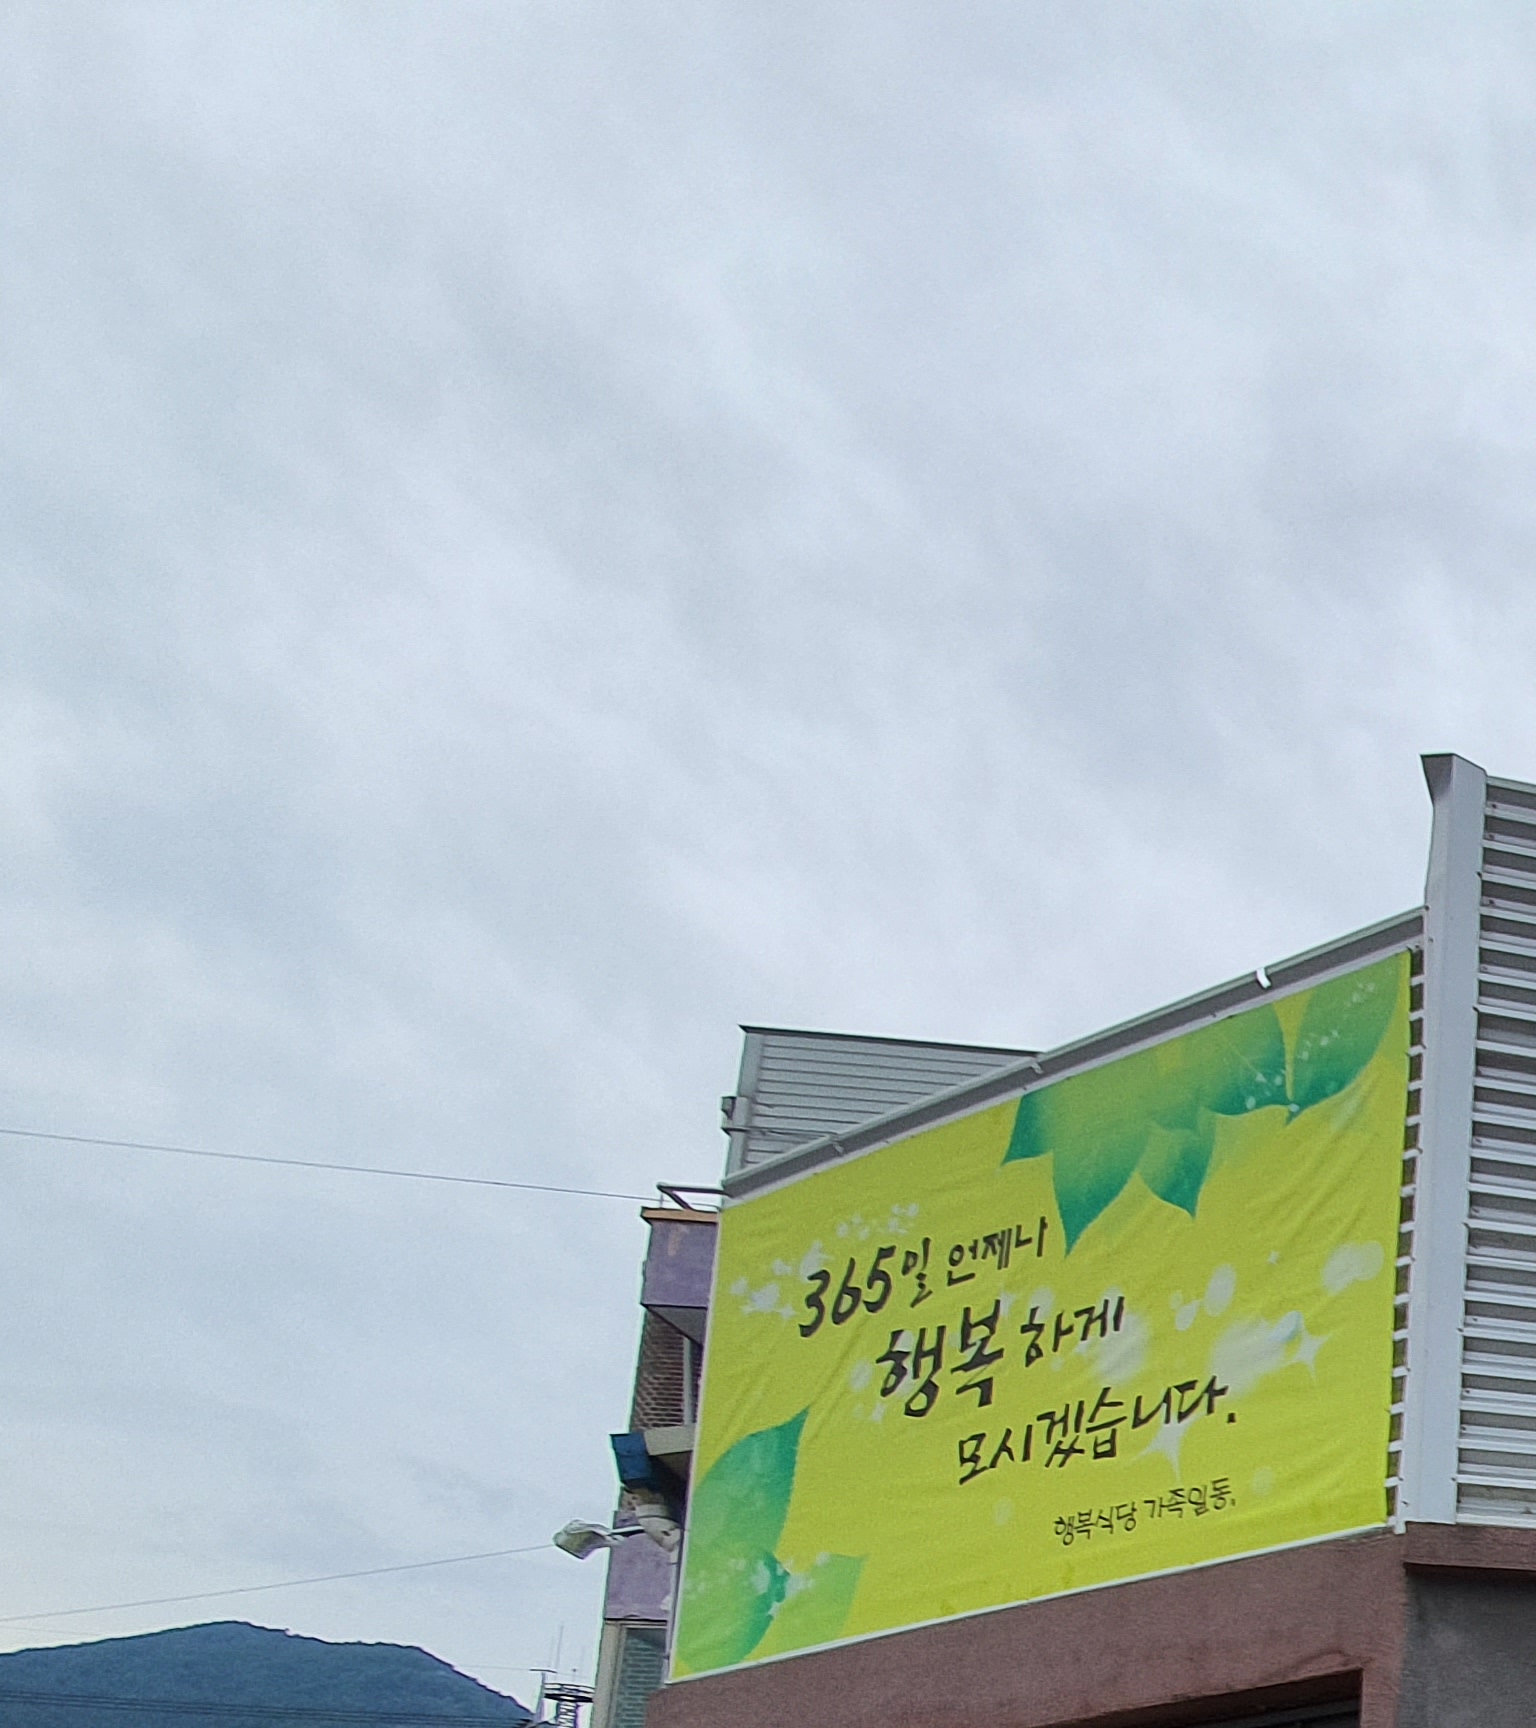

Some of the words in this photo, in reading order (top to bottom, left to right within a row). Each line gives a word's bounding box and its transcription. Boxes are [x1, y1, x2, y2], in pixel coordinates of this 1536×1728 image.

[798, 1237, 932, 1338] 365일
[946, 1216, 1049, 1287] 언제나
[957, 1374, 1238, 1486] 모시겠습니다.
[1054, 1503, 1138, 1546] 행복식당
